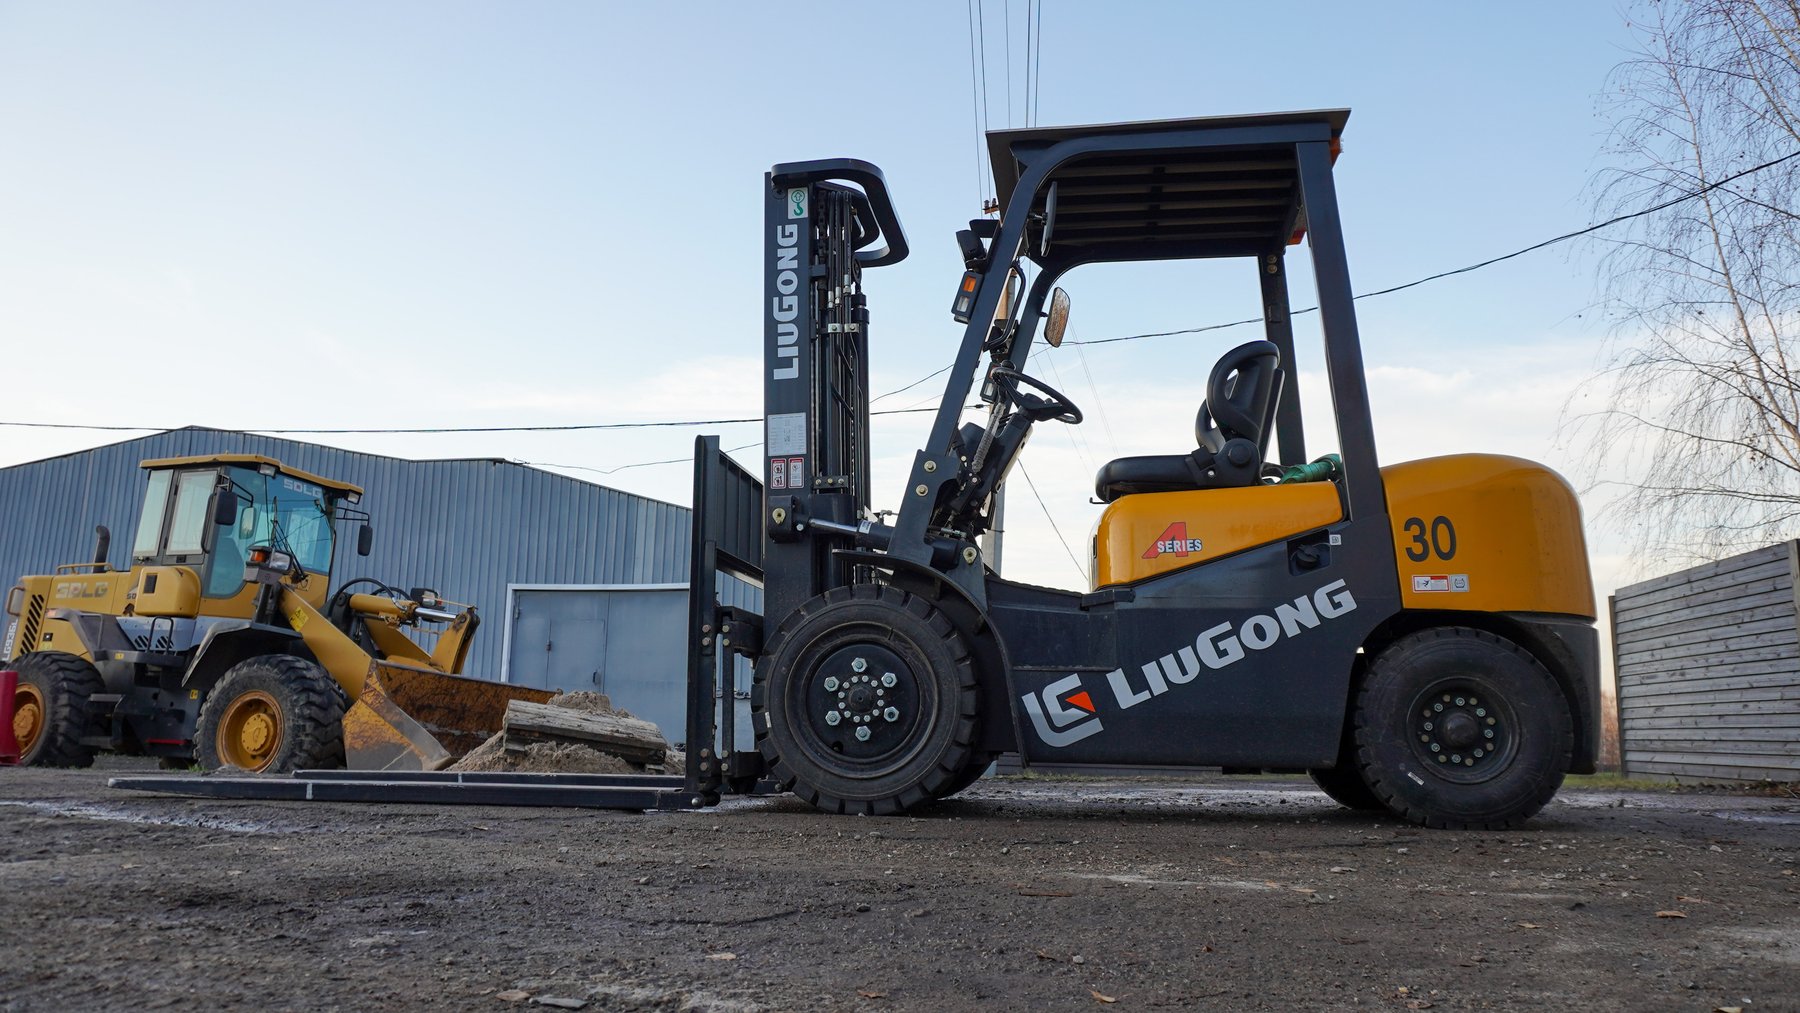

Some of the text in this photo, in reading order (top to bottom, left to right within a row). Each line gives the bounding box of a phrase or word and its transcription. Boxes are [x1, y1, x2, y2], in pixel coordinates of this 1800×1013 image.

[773, 224, 799, 380] LIUGONG
[283, 478, 323, 499] SDLG
[1141, 521, 1189, 559] A
[1157, 539, 1203, 553] SERIES
[1403, 515, 1457, 563] 30
[55, 582, 109, 599] SDLG
[1105, 578, 1358, 710] LIUGONG
